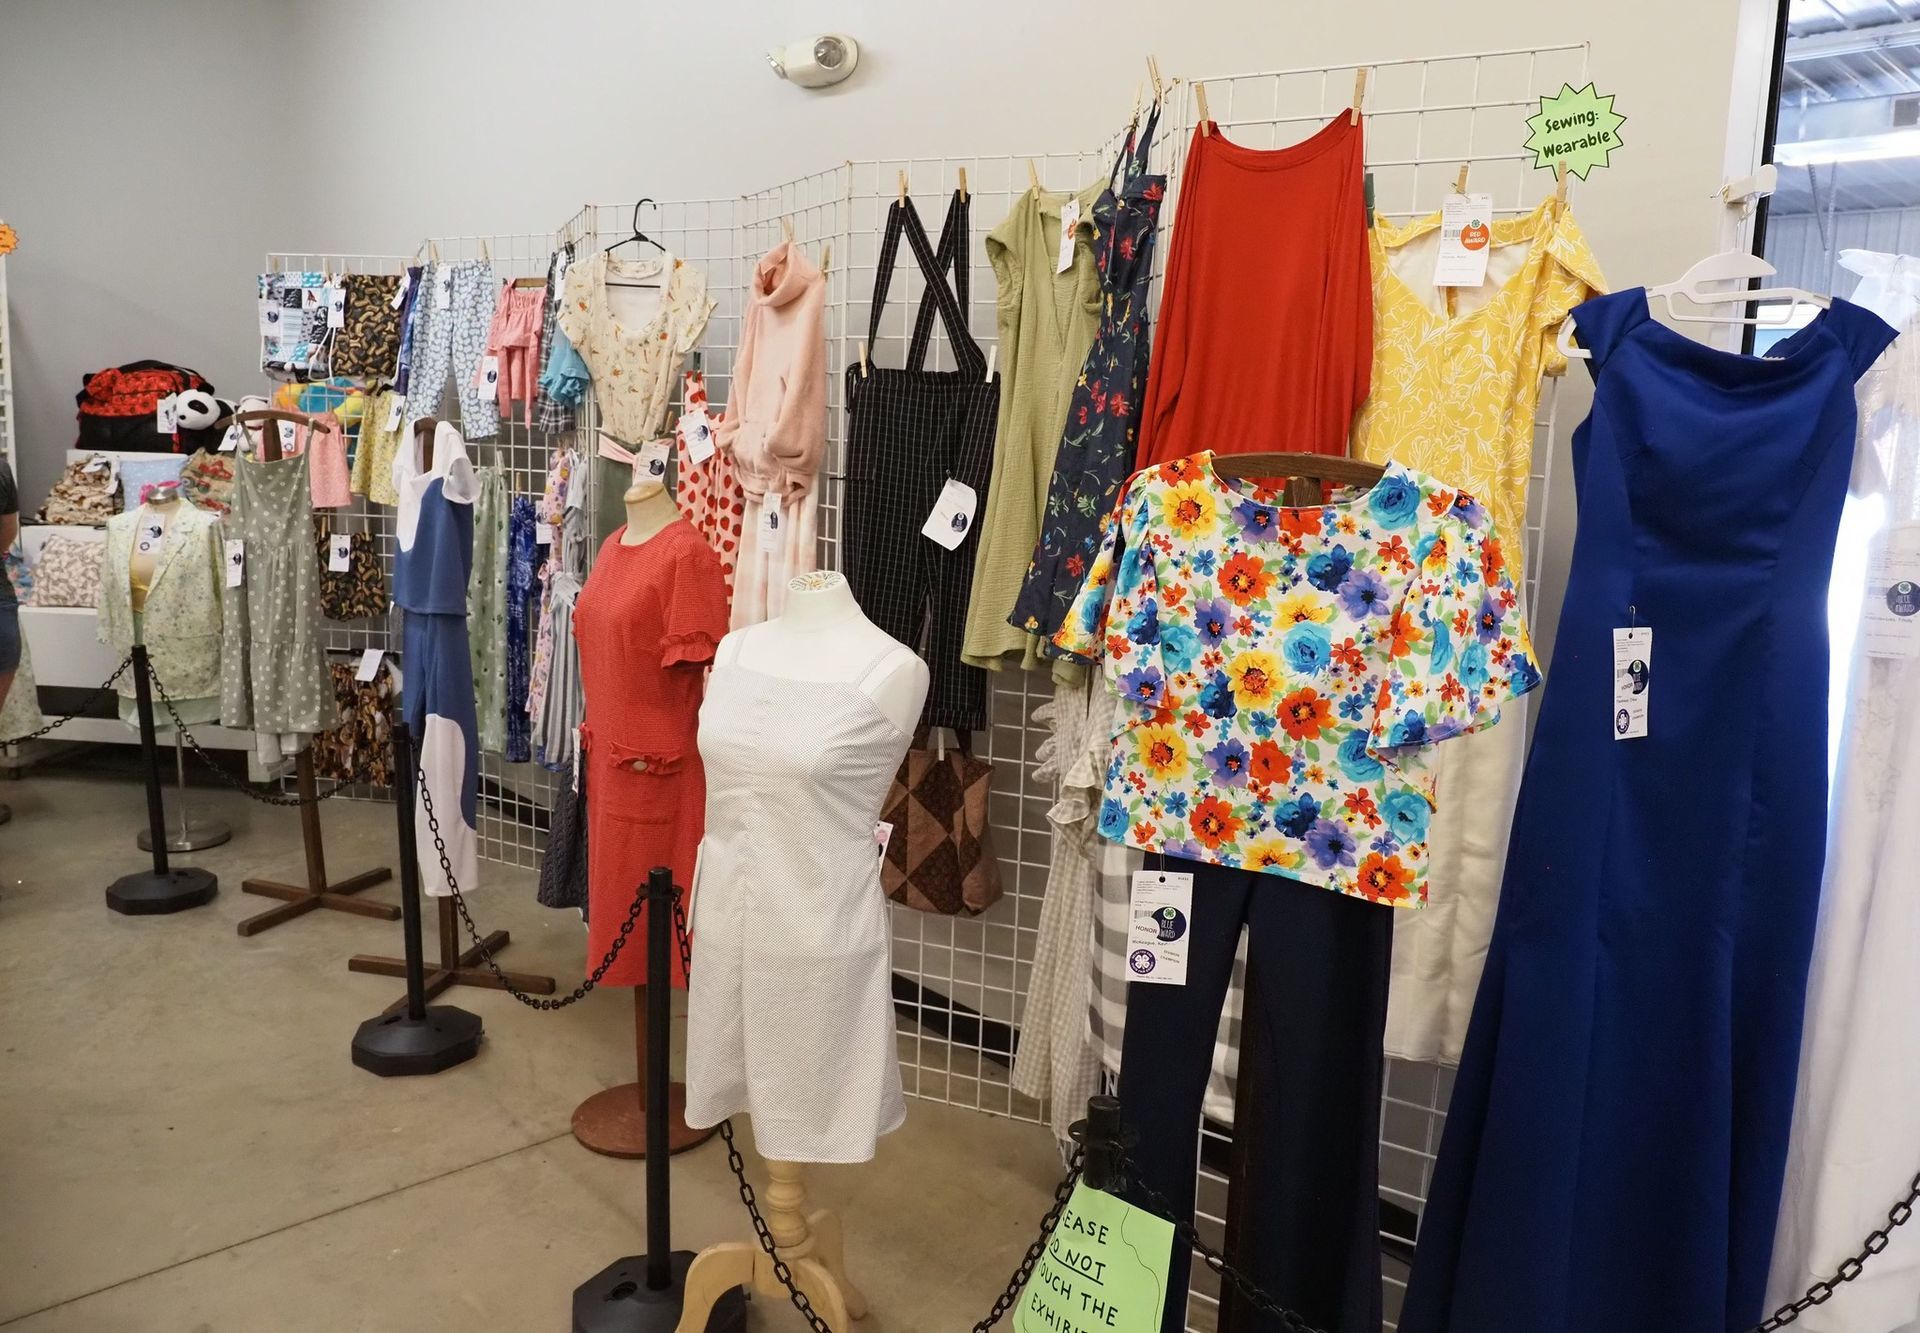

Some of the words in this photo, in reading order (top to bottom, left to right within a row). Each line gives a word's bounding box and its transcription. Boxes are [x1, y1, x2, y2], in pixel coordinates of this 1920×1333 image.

[1545, 110, 1600, 134] Sewing:
[1543, 131, 1611, 158] Wearable
[1135, 925, 1158, 934] HONOR
[1160, 929, 1175, 938] WARD
[1161, 919, 1174, 929] BLUE
[1062, 1209, 1109, 1245] EASE
[1065, 1249, 1106, 1280] NOT
[1039, 1257, 1072, 1301] OUCH
[1081, 1292, 1119, 1327] THE
